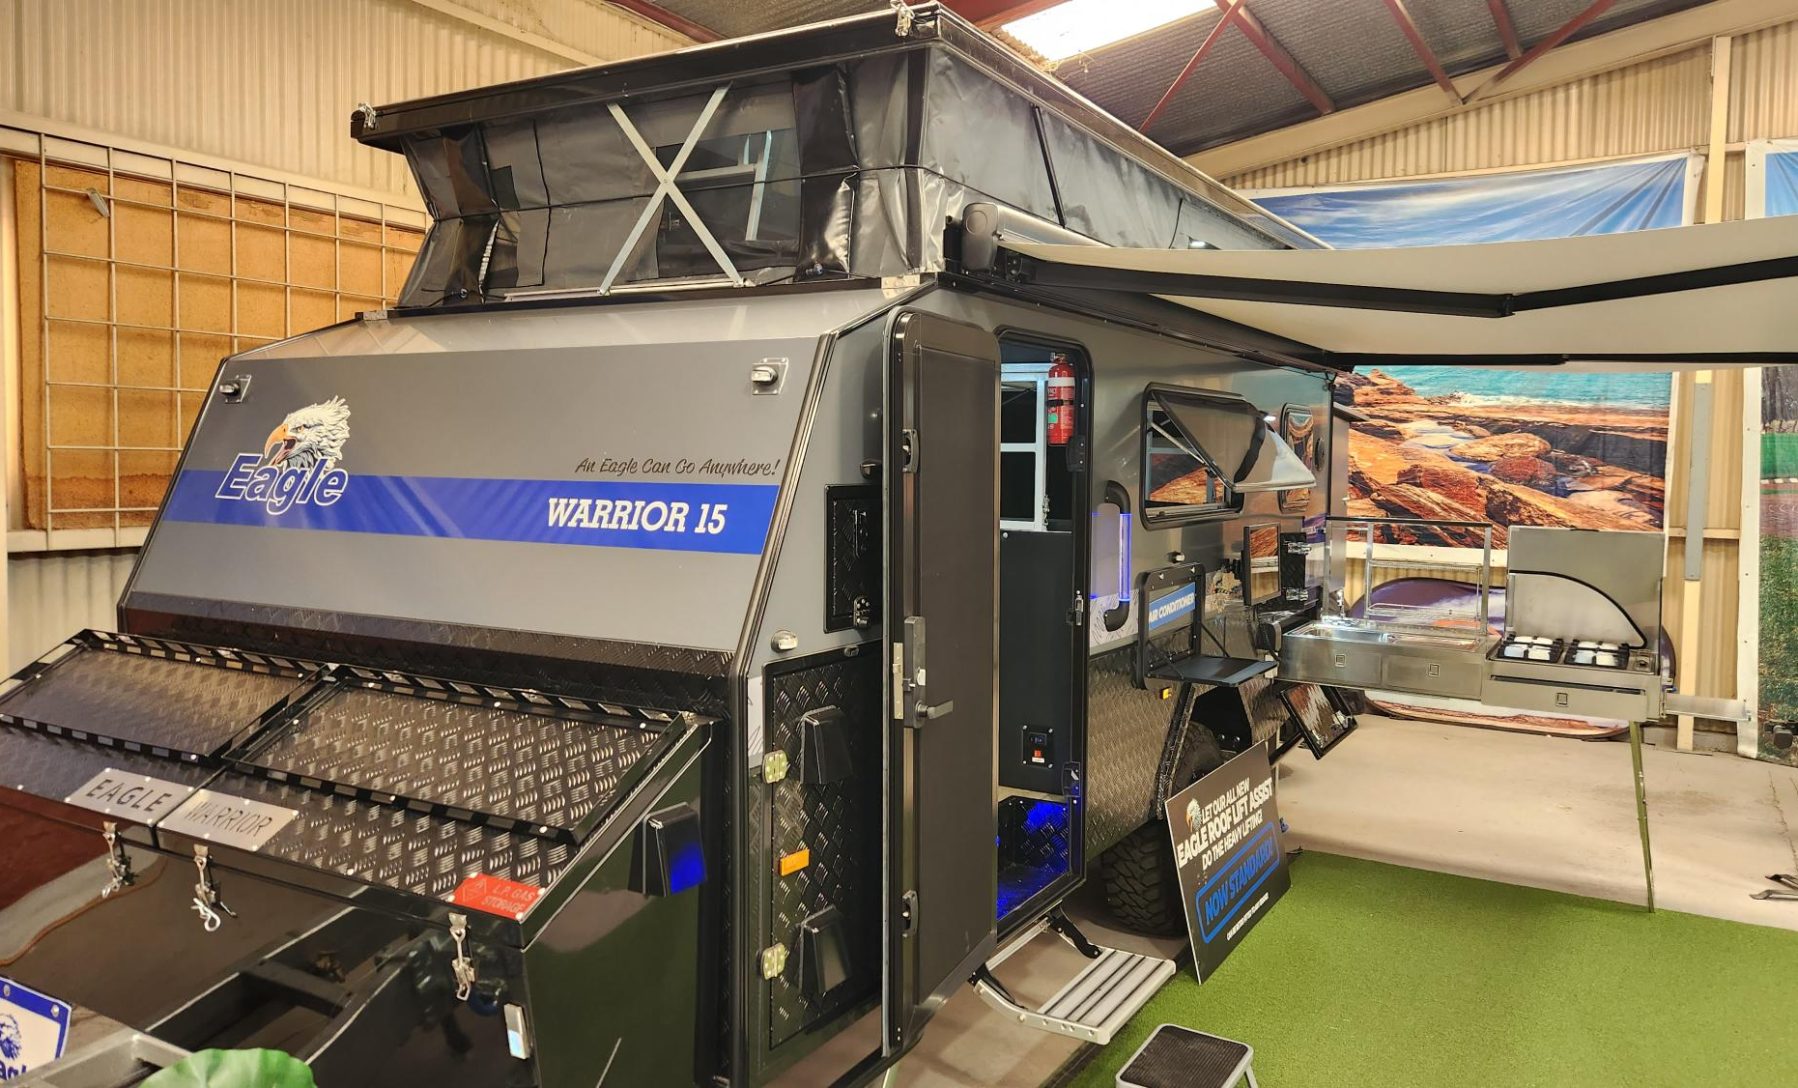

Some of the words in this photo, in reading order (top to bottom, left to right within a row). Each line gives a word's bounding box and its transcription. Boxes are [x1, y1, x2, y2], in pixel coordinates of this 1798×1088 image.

[215, 453, 349, 515] Eagle
[574, 457, 595, 473] An
[599, 458, 638, 477] Eagle
[641, 458, 671, 474] Can
[675, 459, 695, 474] Go
[698, 458, 781, 478] Anywhere!
[548, 497, 689, 533] WARRIOR
[694, 503, 728, 535] 15
[86, 779, 173, 812] EAGLE
[1201, 803, 1213, 824] LET
[1213, 795, 1226, 816] OUR
[1226, 787, 1237, 806] ALL
[1236, 777, 1250, 799] NEW
[186, 800, 273, 837] WARRIOR
[1177, 825, 1209, 868] EAGLE
[1208, 805, 1233, 843] ROOF
[1232, 794, 1249, 825] LIFT
[1249, 777, 1273, 812] ASSIST
[1202, 851, 1212, 870] DO
[1212, 840, 1225, 862] THE
[1224, 824, 1242, 852] HEAVY
[481, 896, 526, 913] STORAGE
[511, 889, 535, 901] GAS
[1205, 881, 1229, 926] NOW
